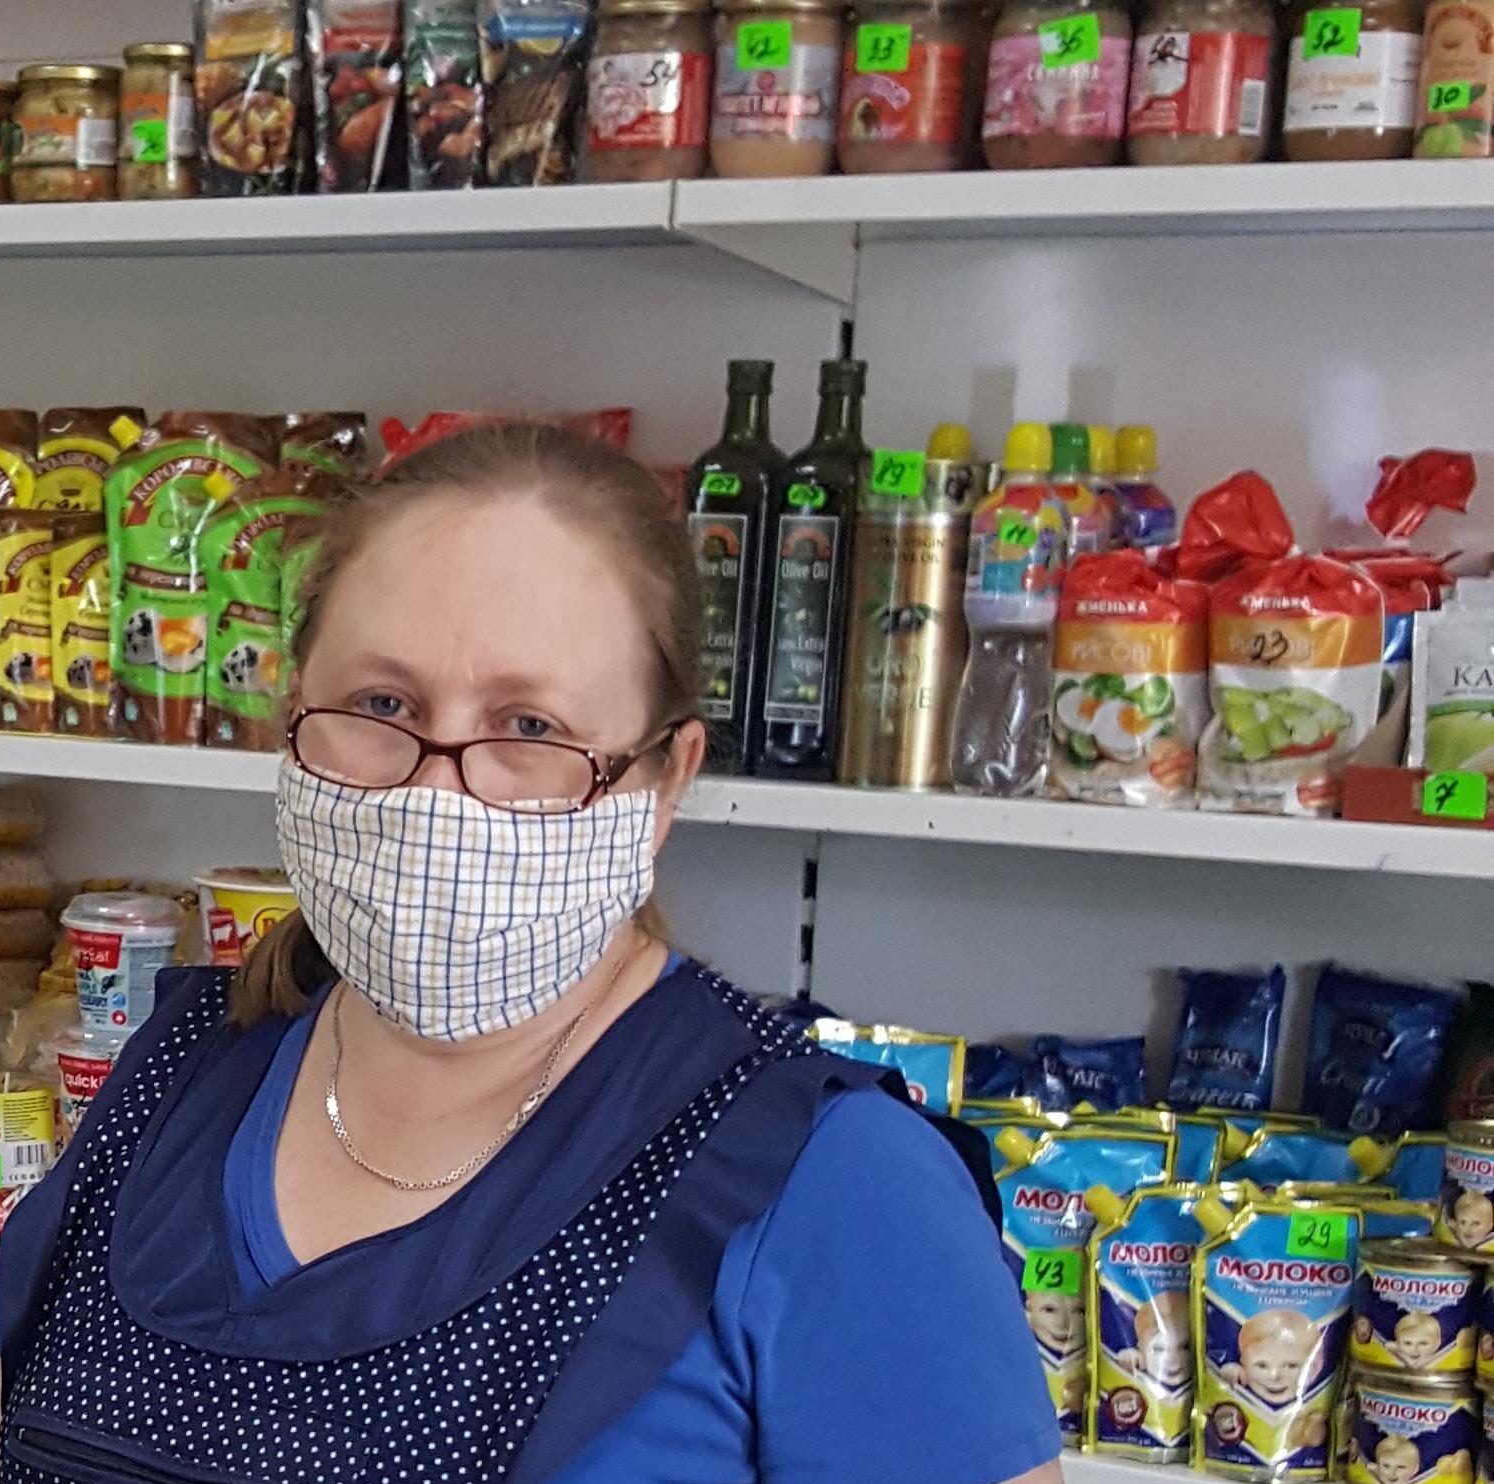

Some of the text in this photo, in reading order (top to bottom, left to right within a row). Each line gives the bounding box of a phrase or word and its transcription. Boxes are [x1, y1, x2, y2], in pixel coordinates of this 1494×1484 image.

[1249, 628, 1289, 666] 23
[1014, 1185, 1089, 1214] МОЛ
[1297, 1217, 1333, 1249] 29
[1033, 1256, 1065, 1289] 43
[1216, 1255, 1354, 1288] МОЛОКО
[1372, 1273, 1468, 1298] МОЛОКО
[1361, 1394, 1448, 1423] МОЛОКО
